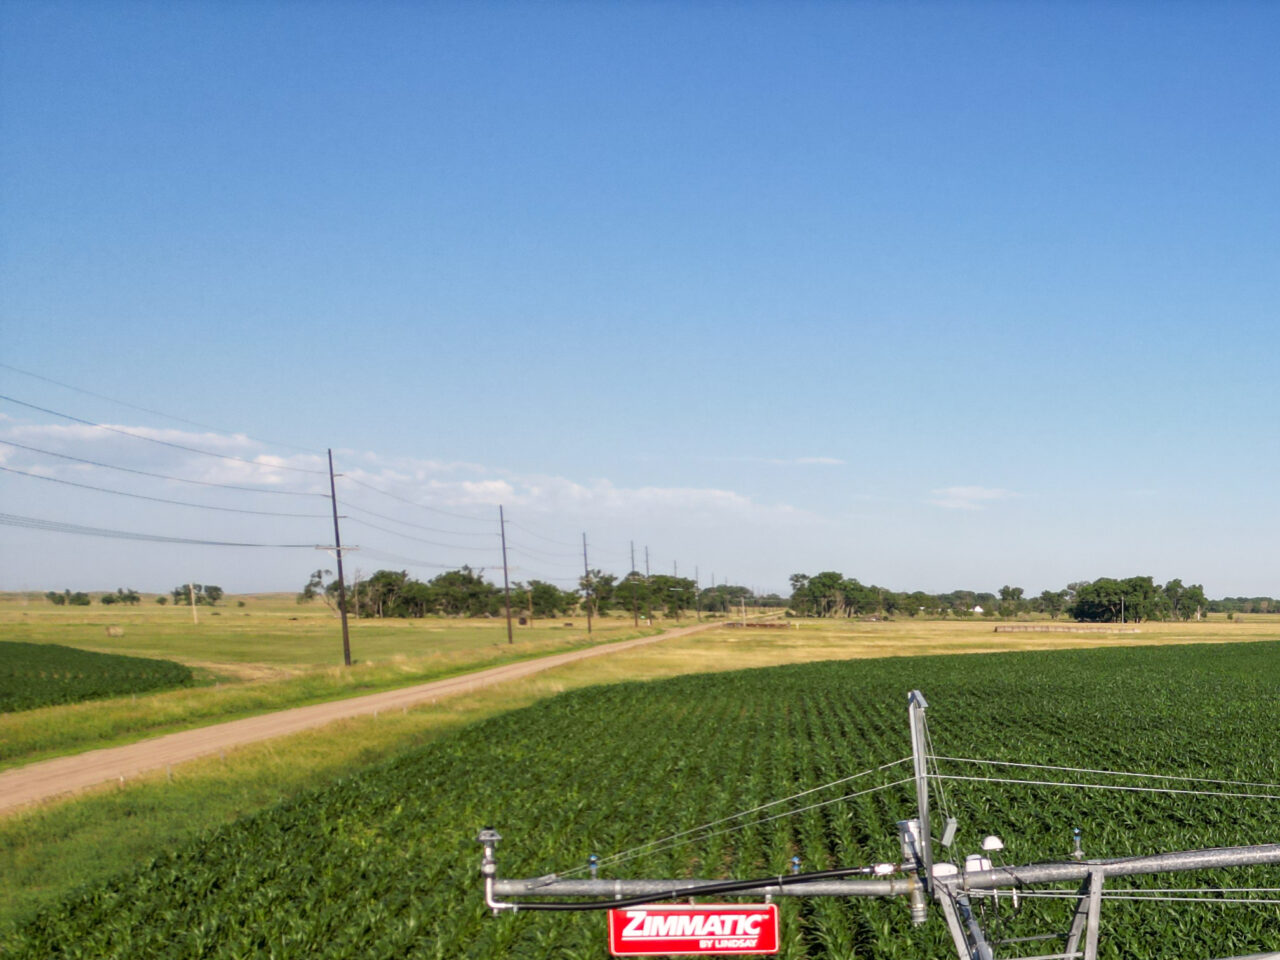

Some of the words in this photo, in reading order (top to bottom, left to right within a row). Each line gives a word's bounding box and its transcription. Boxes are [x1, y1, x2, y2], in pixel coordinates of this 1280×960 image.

[622, 911, 762, 937] ZIMMATIC
[699, 939, 713, 949] BY
[715, 938, 758, 948] LINDSAY
